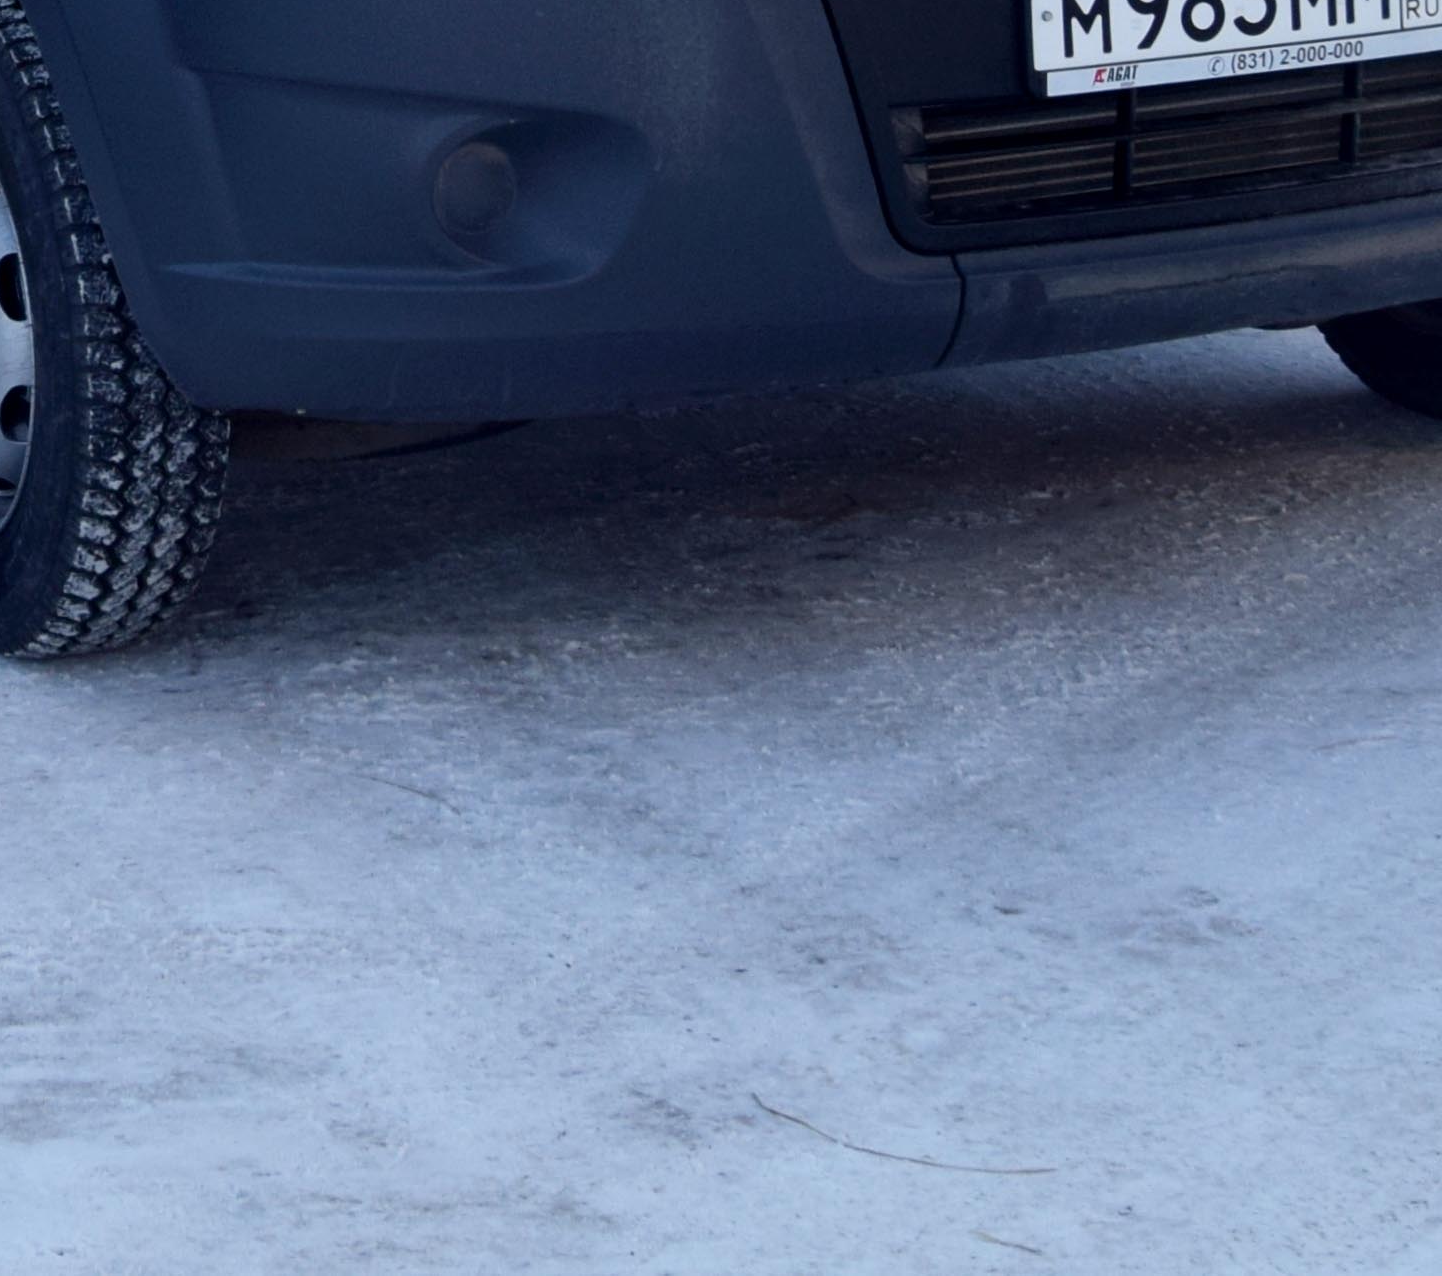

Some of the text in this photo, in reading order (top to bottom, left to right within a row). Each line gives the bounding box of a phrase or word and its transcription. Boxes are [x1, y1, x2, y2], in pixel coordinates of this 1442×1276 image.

[1231, 40, 1364, 73] (831) 2-000-000
[1106, 64, 1139, 82] AGAT
